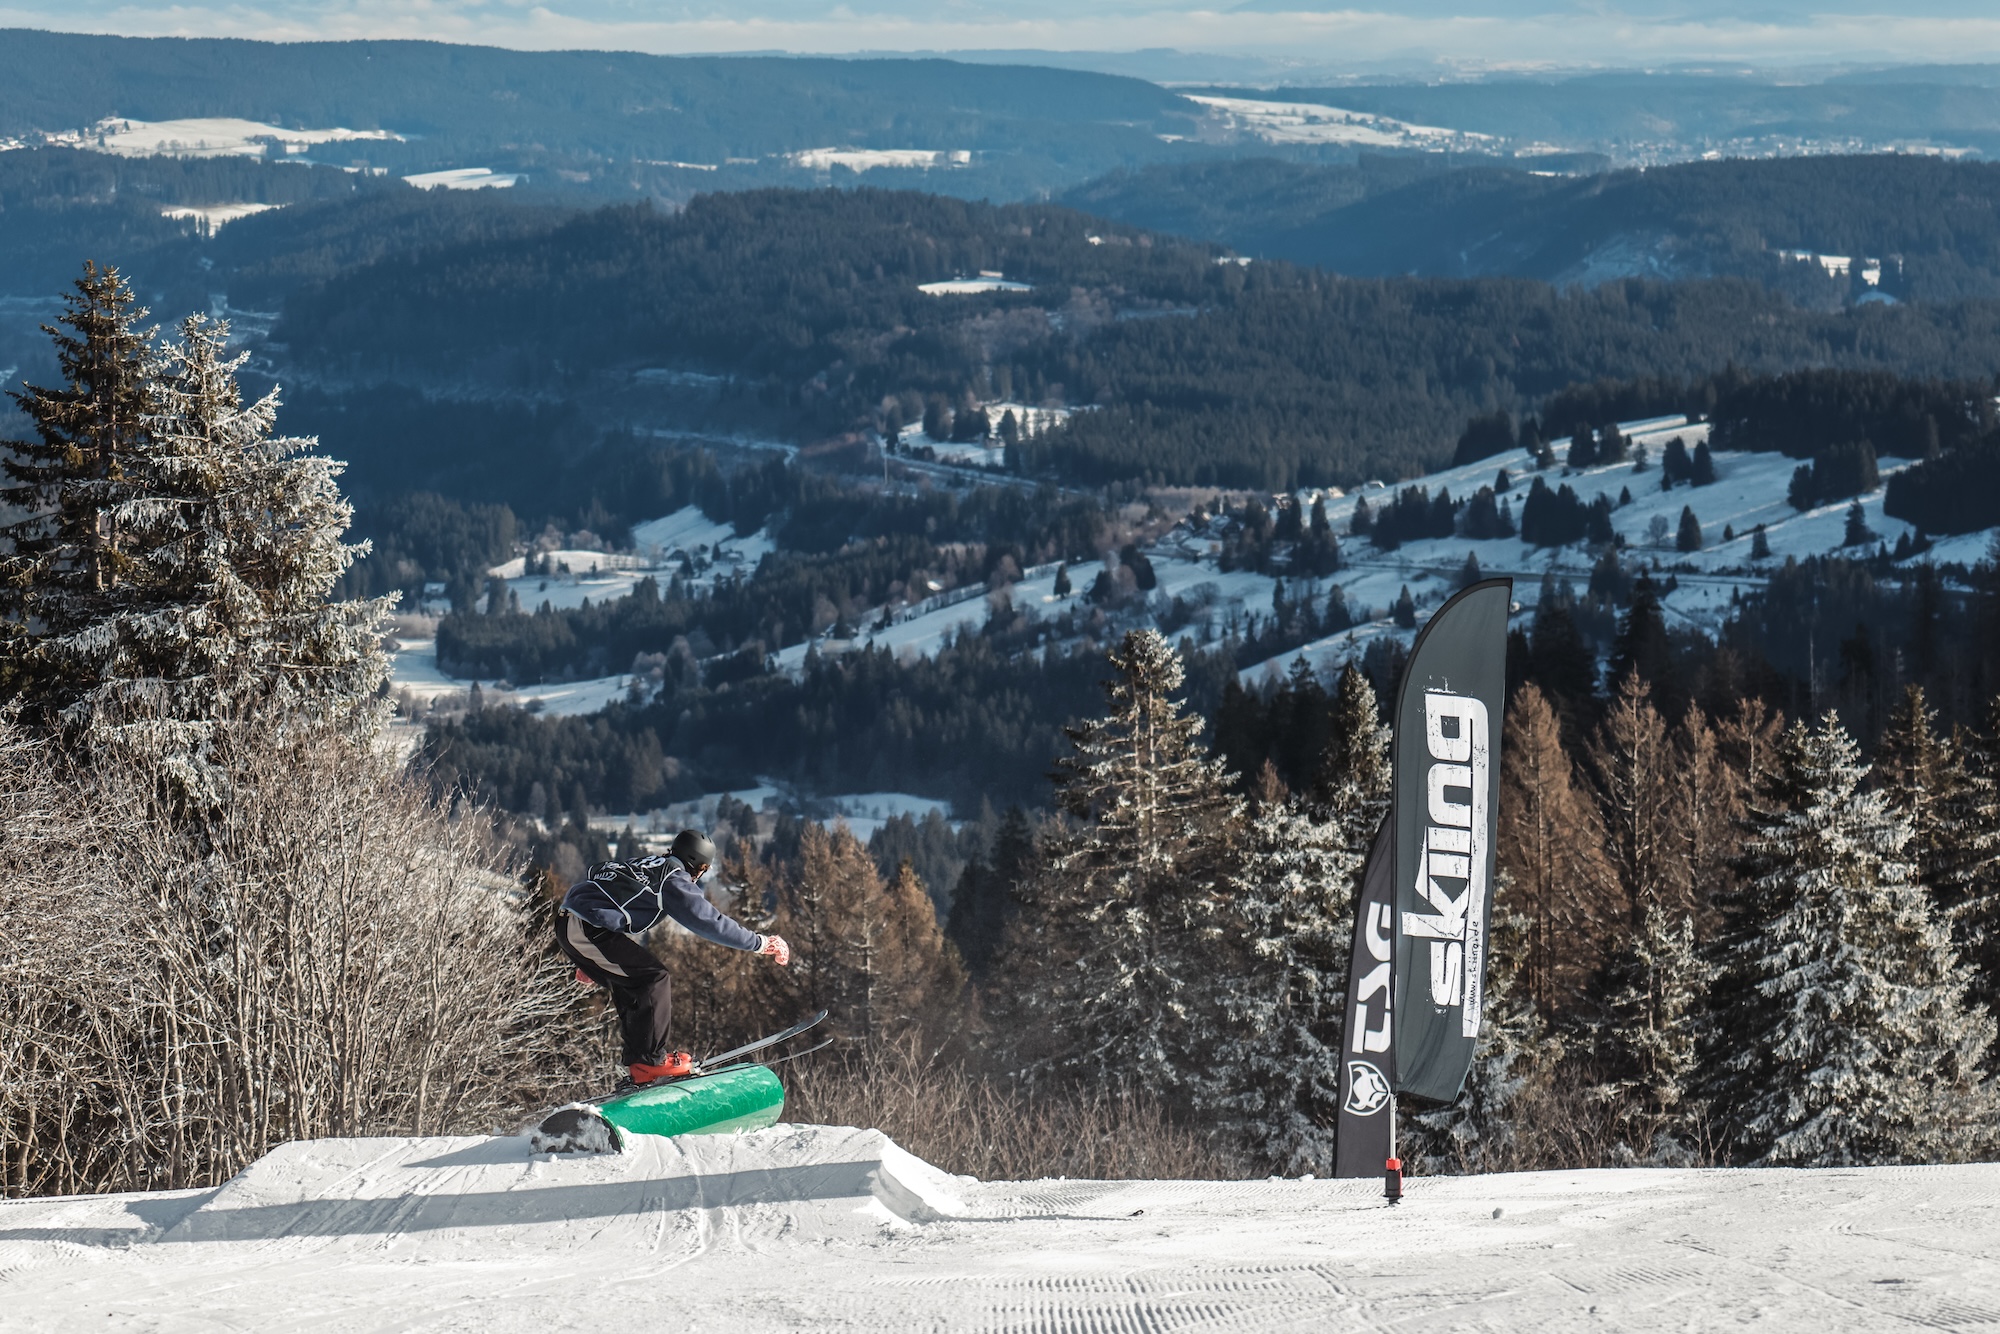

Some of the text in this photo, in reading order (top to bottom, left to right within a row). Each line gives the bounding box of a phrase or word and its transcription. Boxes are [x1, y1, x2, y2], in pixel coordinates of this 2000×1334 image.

[1402, 692, 1488, 1036] skiing
[1352, 901, 1391, 1054] TSG
[1467, 921, 1480, 1011] www.skiing.de
